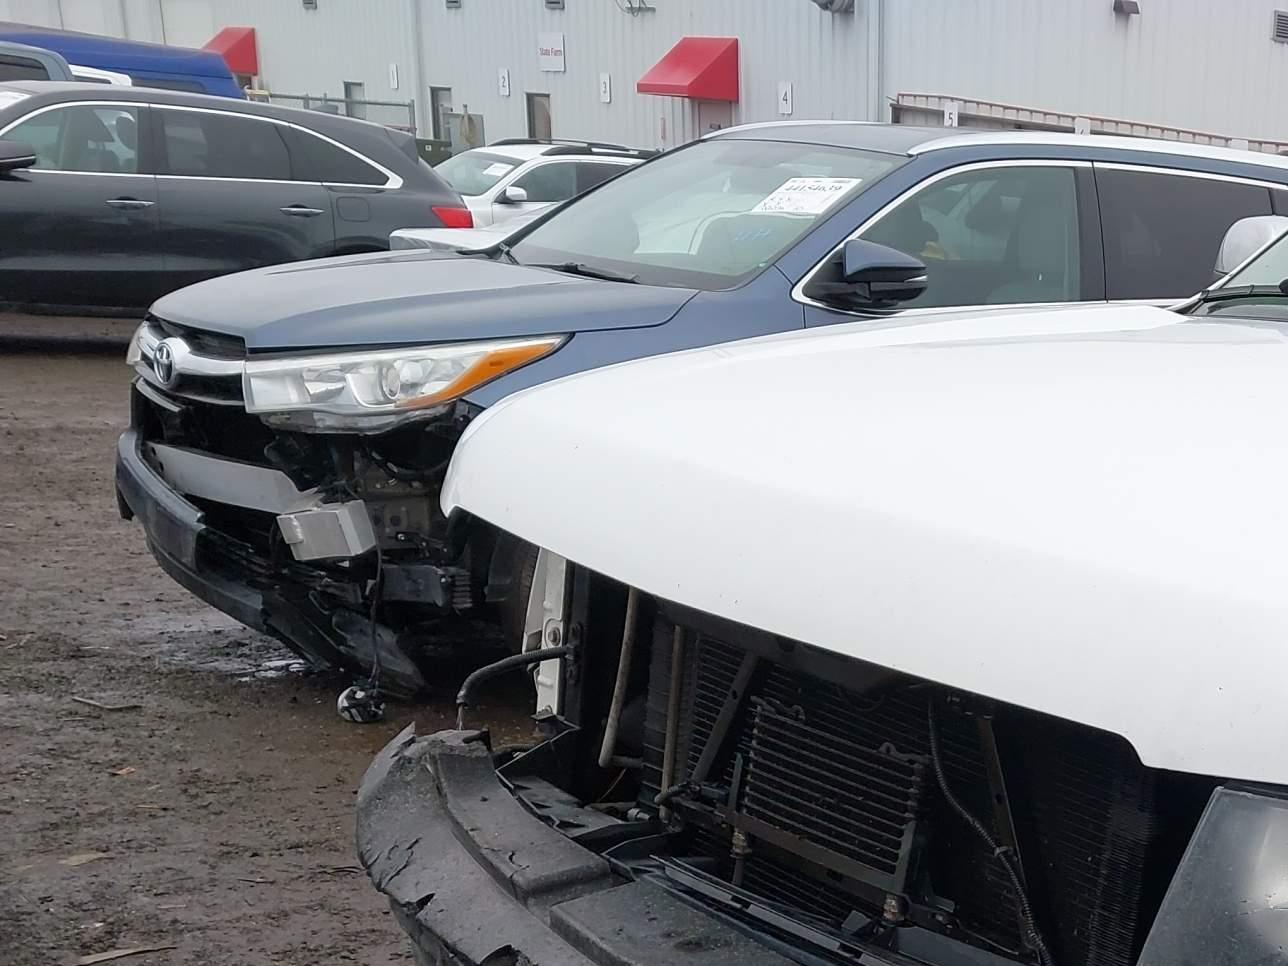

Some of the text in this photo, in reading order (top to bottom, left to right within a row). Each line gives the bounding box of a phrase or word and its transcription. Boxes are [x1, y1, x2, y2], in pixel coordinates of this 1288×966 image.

[539, 47, 563, 56] State Farm
[782, 90, 788, 105] 4
